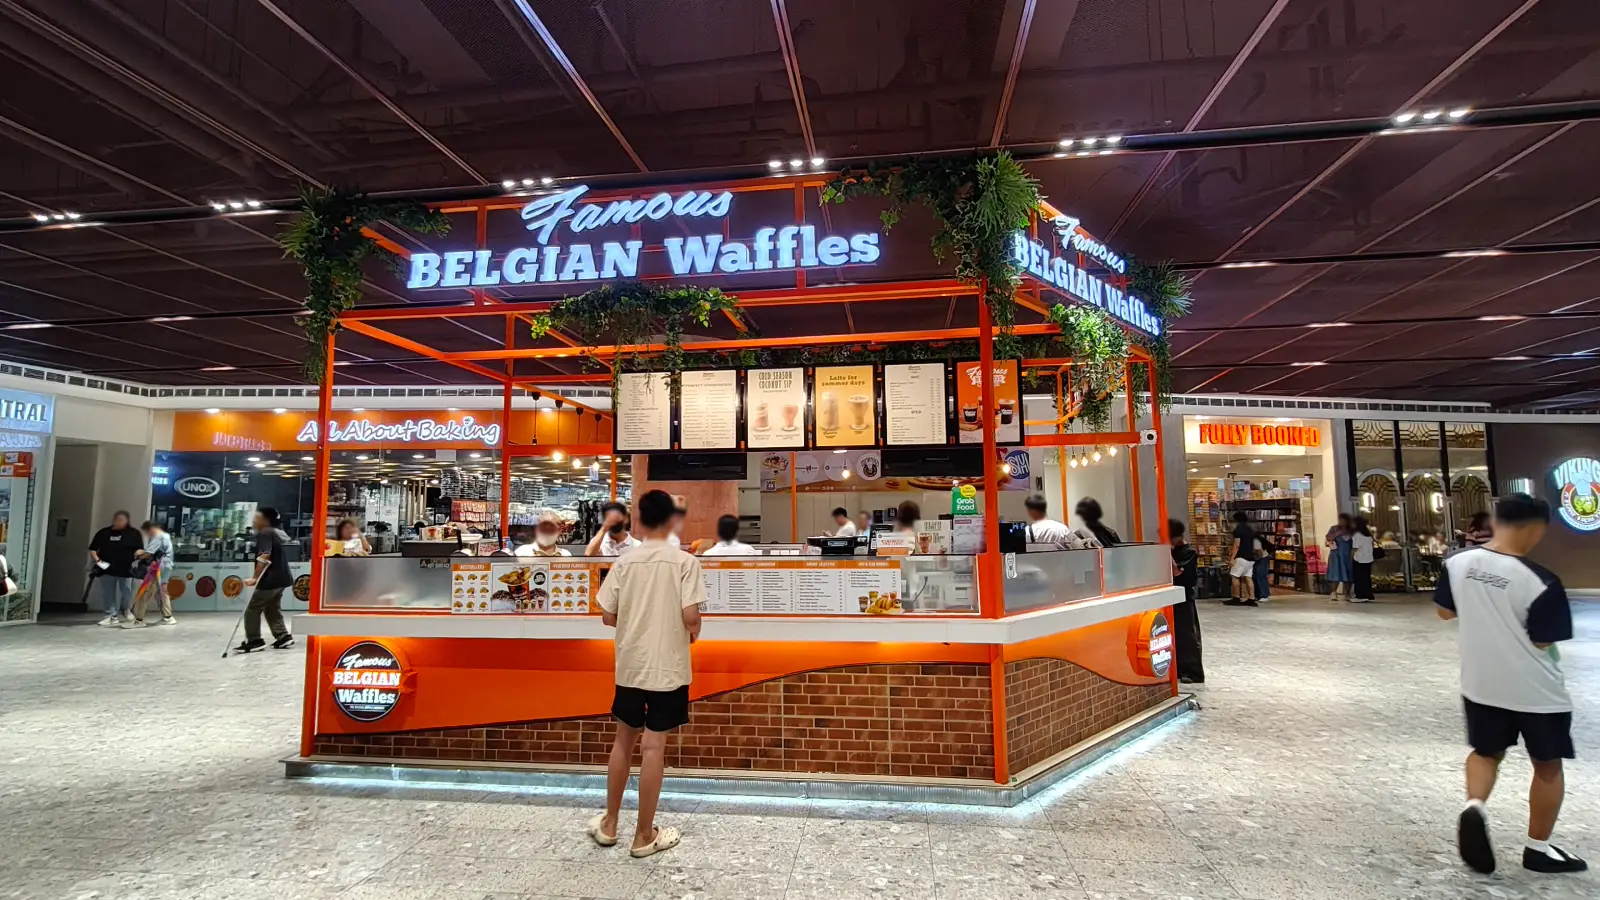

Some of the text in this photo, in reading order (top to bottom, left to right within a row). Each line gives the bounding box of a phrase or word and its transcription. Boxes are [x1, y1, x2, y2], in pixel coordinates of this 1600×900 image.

[521, 185, 733, 245] Famous
[1055, 215, 1126, 274] Famous
[407, 225, 881, 289] BELGIAN Waffles
[1015, 233, 1161, 336] BELGIAN Waffles
[759, 371, 793, 380] COLD SEASON
[759, 380, 793, 389] COCONUT SIP
[0, 399, 47, 422] TRAL
[297, 420, 342, 442] Al
[341, 420, 416, 442] About
[418, 416, 500, 446] Baking
[1199, 423, 1321, 447] FULLY BOOKED
[182, 482, 216, 493] UNOX
[342, 653, 392, 670] Famous
[333, 671, 401, 686] BELGIAN
[338, 688, 396, 704] Waffles
